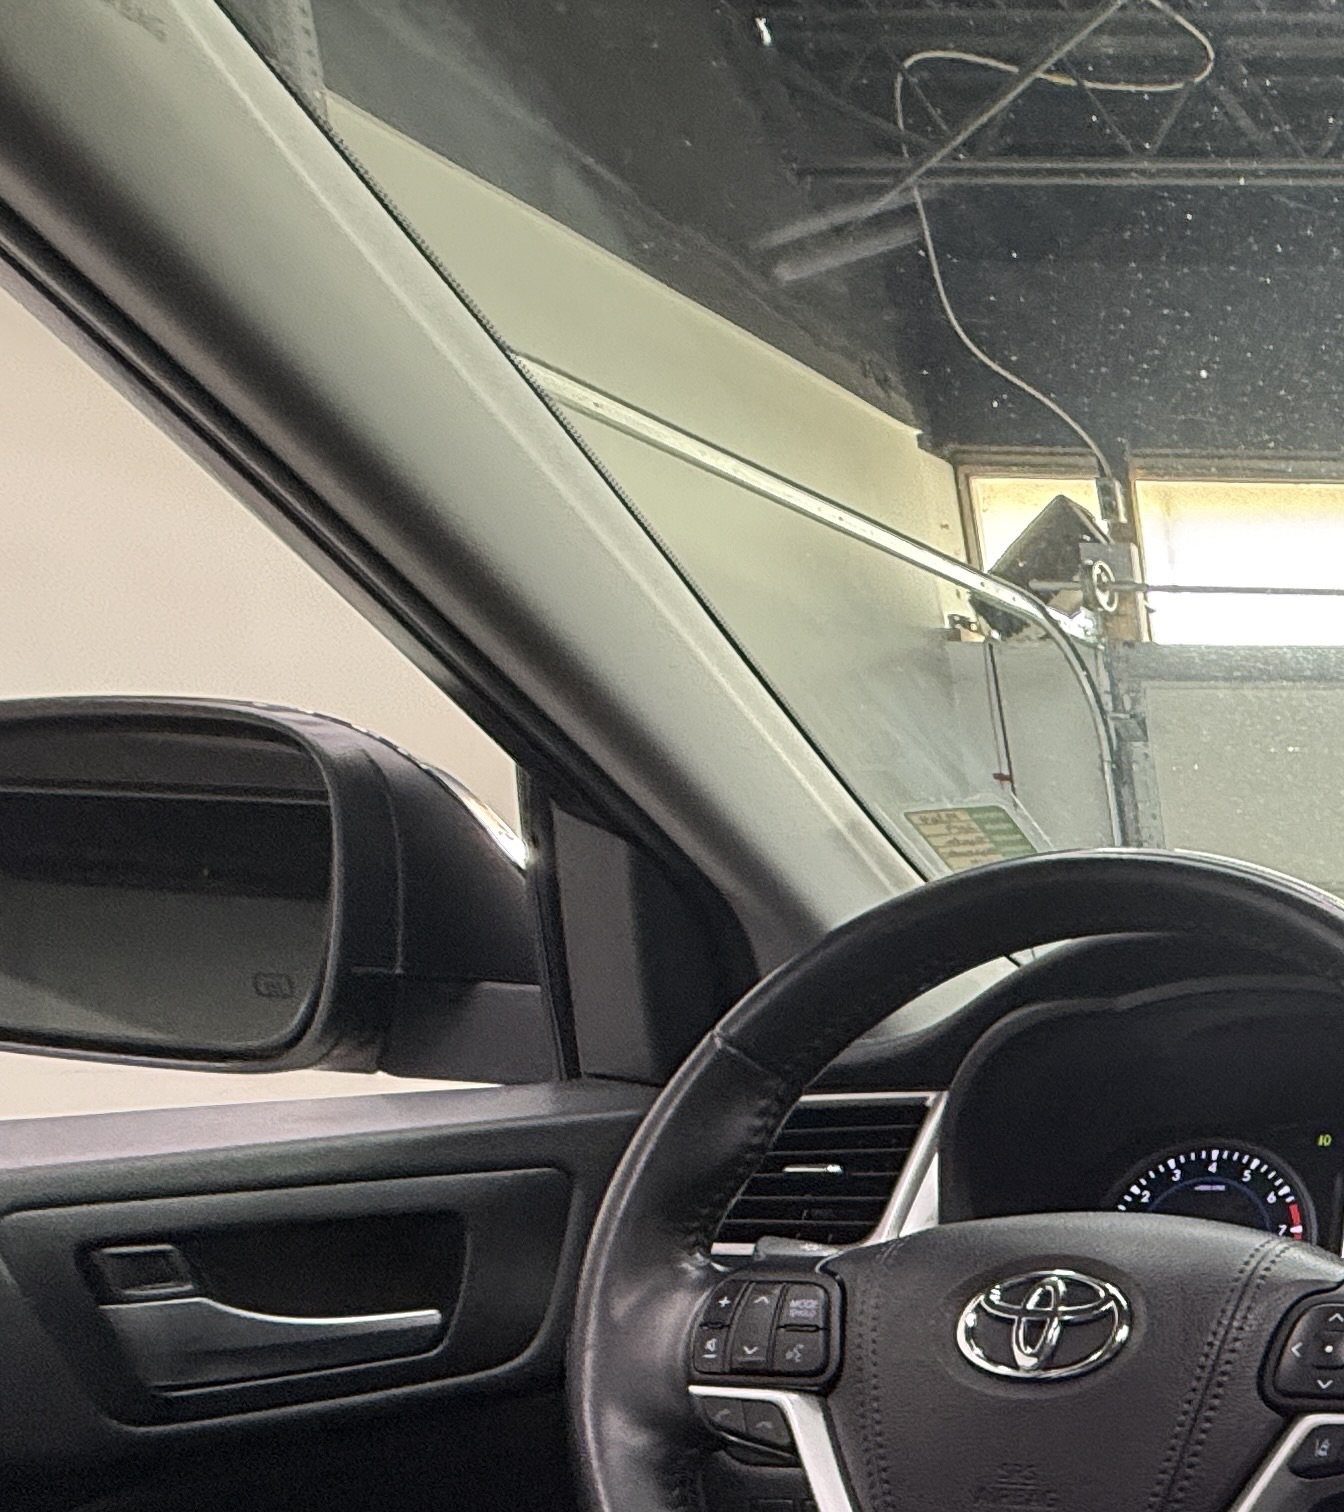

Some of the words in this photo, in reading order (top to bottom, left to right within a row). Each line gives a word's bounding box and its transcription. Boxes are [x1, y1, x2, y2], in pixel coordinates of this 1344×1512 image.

[1208, 1162, 1217, 1173] 4
[1171, 1169, 1181, 1182] 3
[1242, 1170, 1251, 1182] 5
[1140, 1190, 1150, 1203] 2
[1267, 1191, 1277, 1204] 6
[1278, 1224, 1287, 1236] 7
